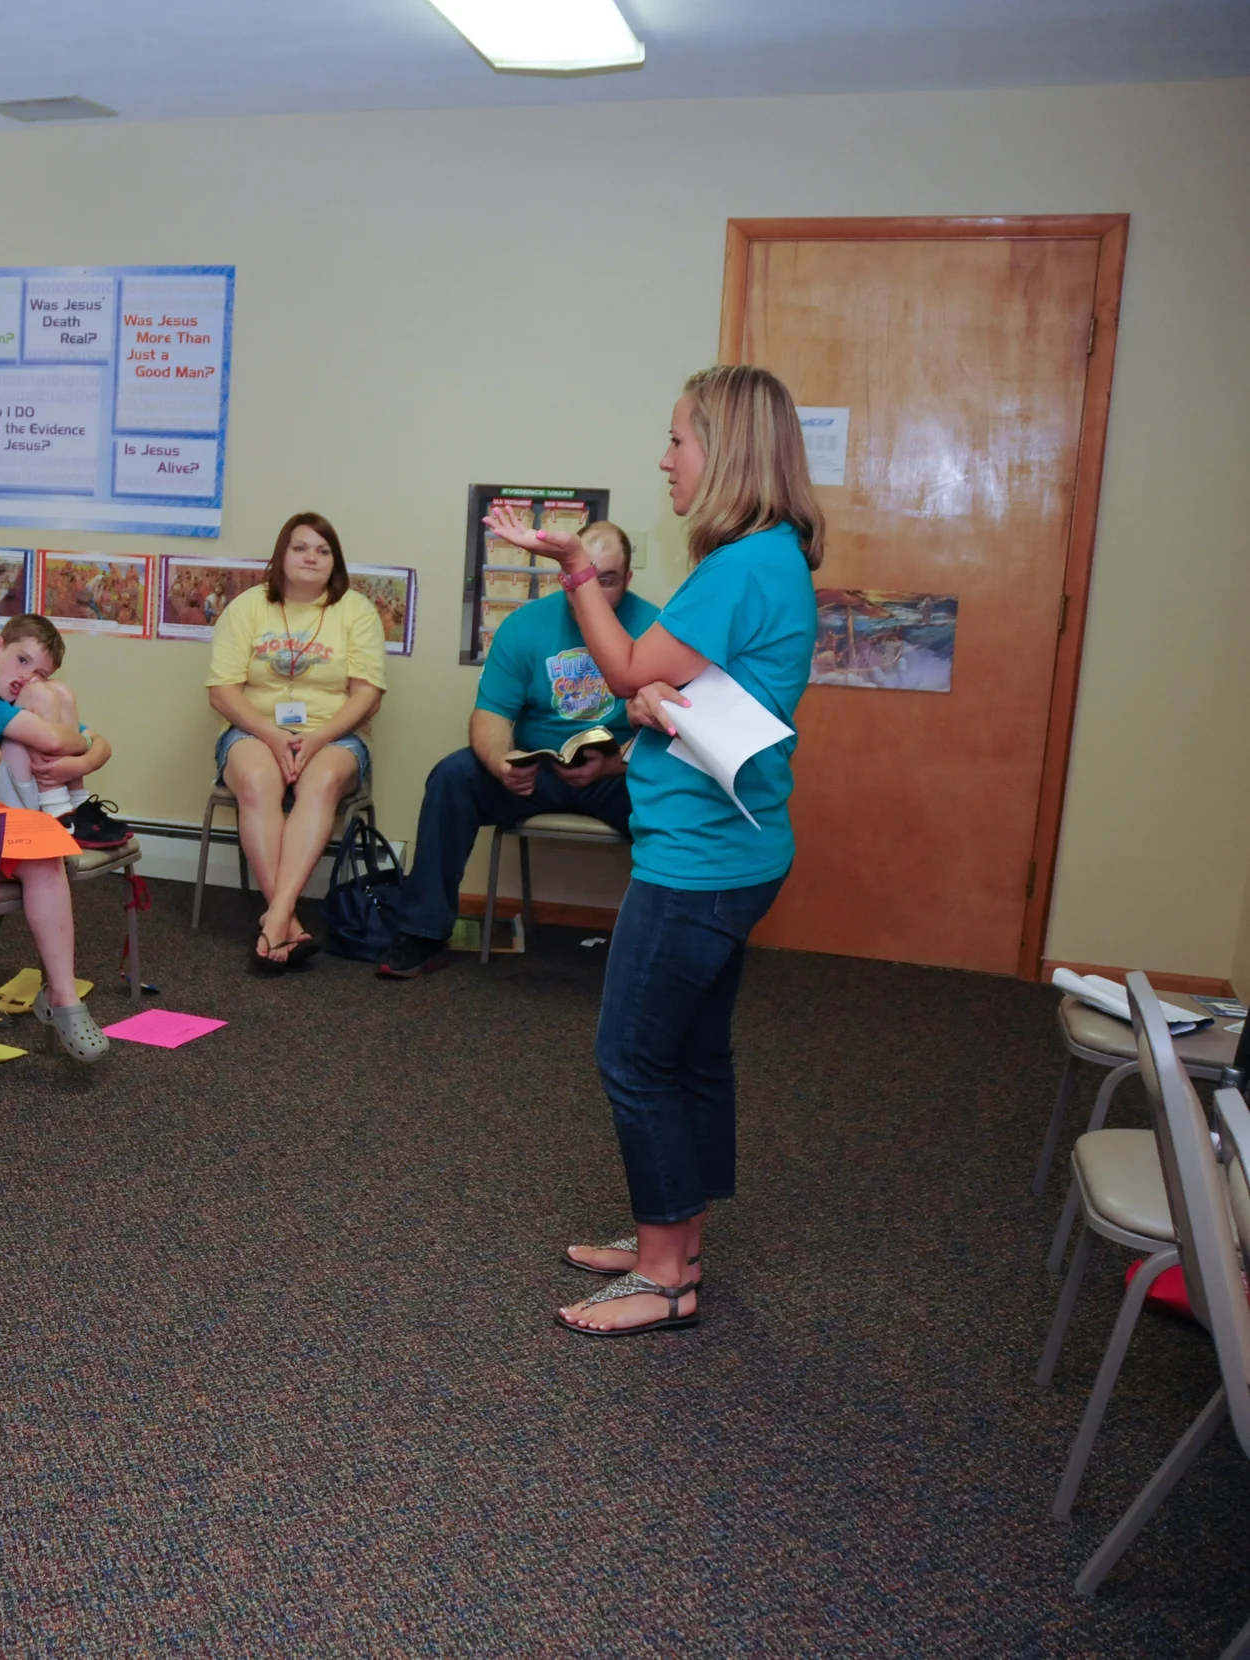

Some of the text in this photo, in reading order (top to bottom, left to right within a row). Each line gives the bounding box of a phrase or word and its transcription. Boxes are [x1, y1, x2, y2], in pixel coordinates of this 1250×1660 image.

[30, 296, 105, 311] Was Jesus'
[42, 316, 80, 328] Death
[124, 315, 198, 327] Was Jesus
[60, 333, 97, 345] Real?
[136, 333, 210, 344] More Than
[126, 349, 169, 361] Just a
[135, 366, 215, 379] Good Man?
[7, 406, 10, 417] I
[15, 406, 35, 418] DO
[6, 424, 25, 435] the
[30, 423, 86, 436] Evidence
[4, 439, 51, 451] Jesus?
[124, 444, 179, 456] Is Jesus
[157, 462, 199, 474] Alive?
[7, 838, 32, 846] Card
